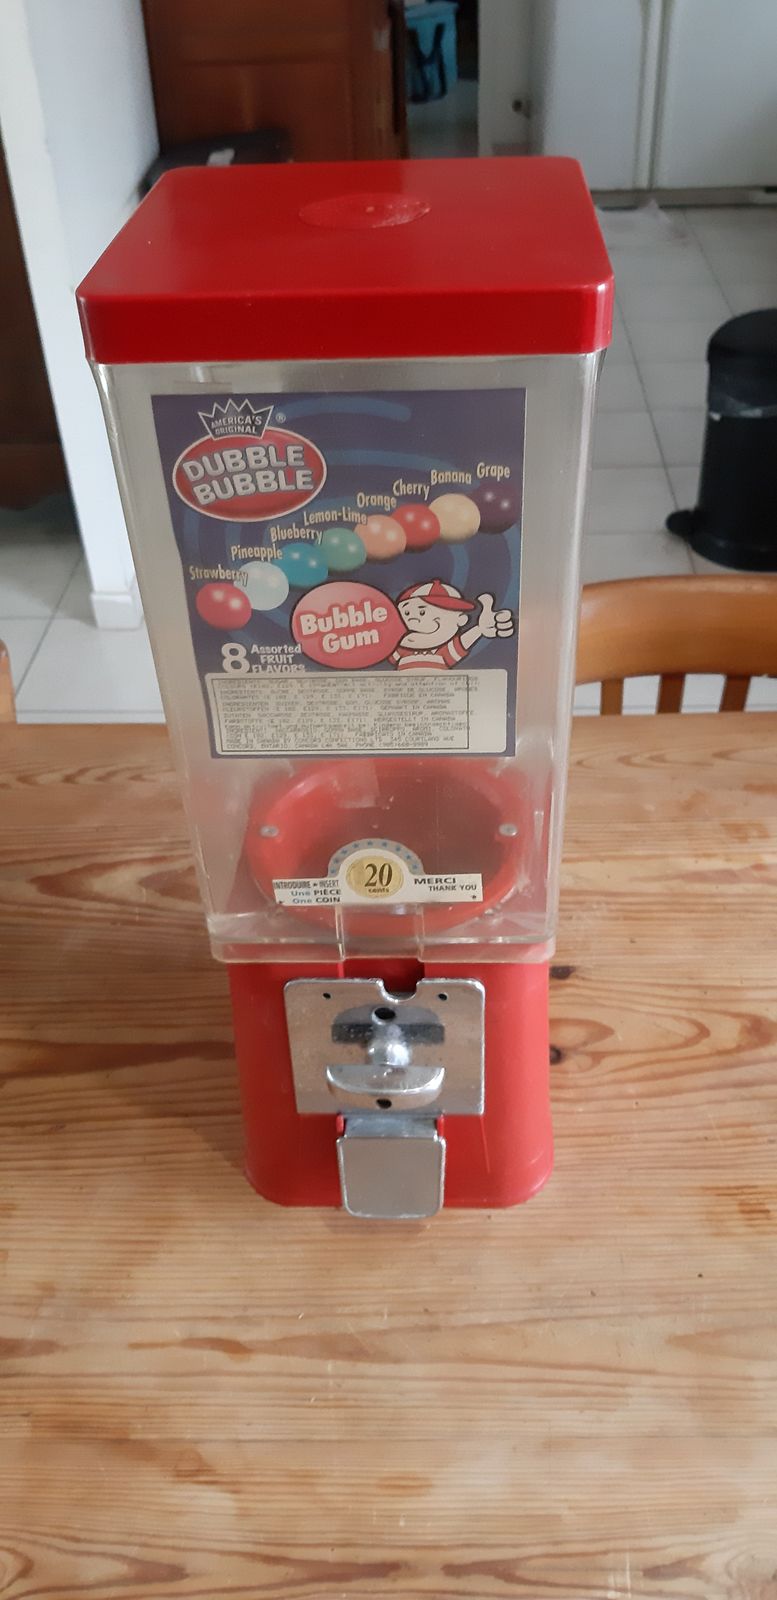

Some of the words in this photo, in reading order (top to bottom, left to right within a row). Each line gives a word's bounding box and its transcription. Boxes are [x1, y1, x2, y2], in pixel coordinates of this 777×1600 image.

[211, 415, 262, 428] AMERICA'S
[215, 425, 257, 435] ORIGINAL
[182, 445, 305, 482] DUBBLE
[476, 462, 511, 482] Grape
[192, 469, 314, 505] BUBBLE
[430, 469, 472, 486] Banana
[393, 478, 430, 501] Cherry
[356, 492, 397, 511] Orange
[303, 506, 368, 526] Lemon-Lime
[270, 522, 323, 544] Blueberry
[230, 543, 283, 562] Pineapple
[189, 564, 249, 587] Strawberry
[299, 601, 388, 636] Bubble
[251, 643, 302, 654] Assorted
[322, 628, 380, 653] Gum
[221, 642, 250, 673] 8
[260, 654, 294, 664] FRUIT
[319, 880, 339, 888] INSERT
[364, 862, 393, 888] 20
[413, 877, 457, 885] MERCI
